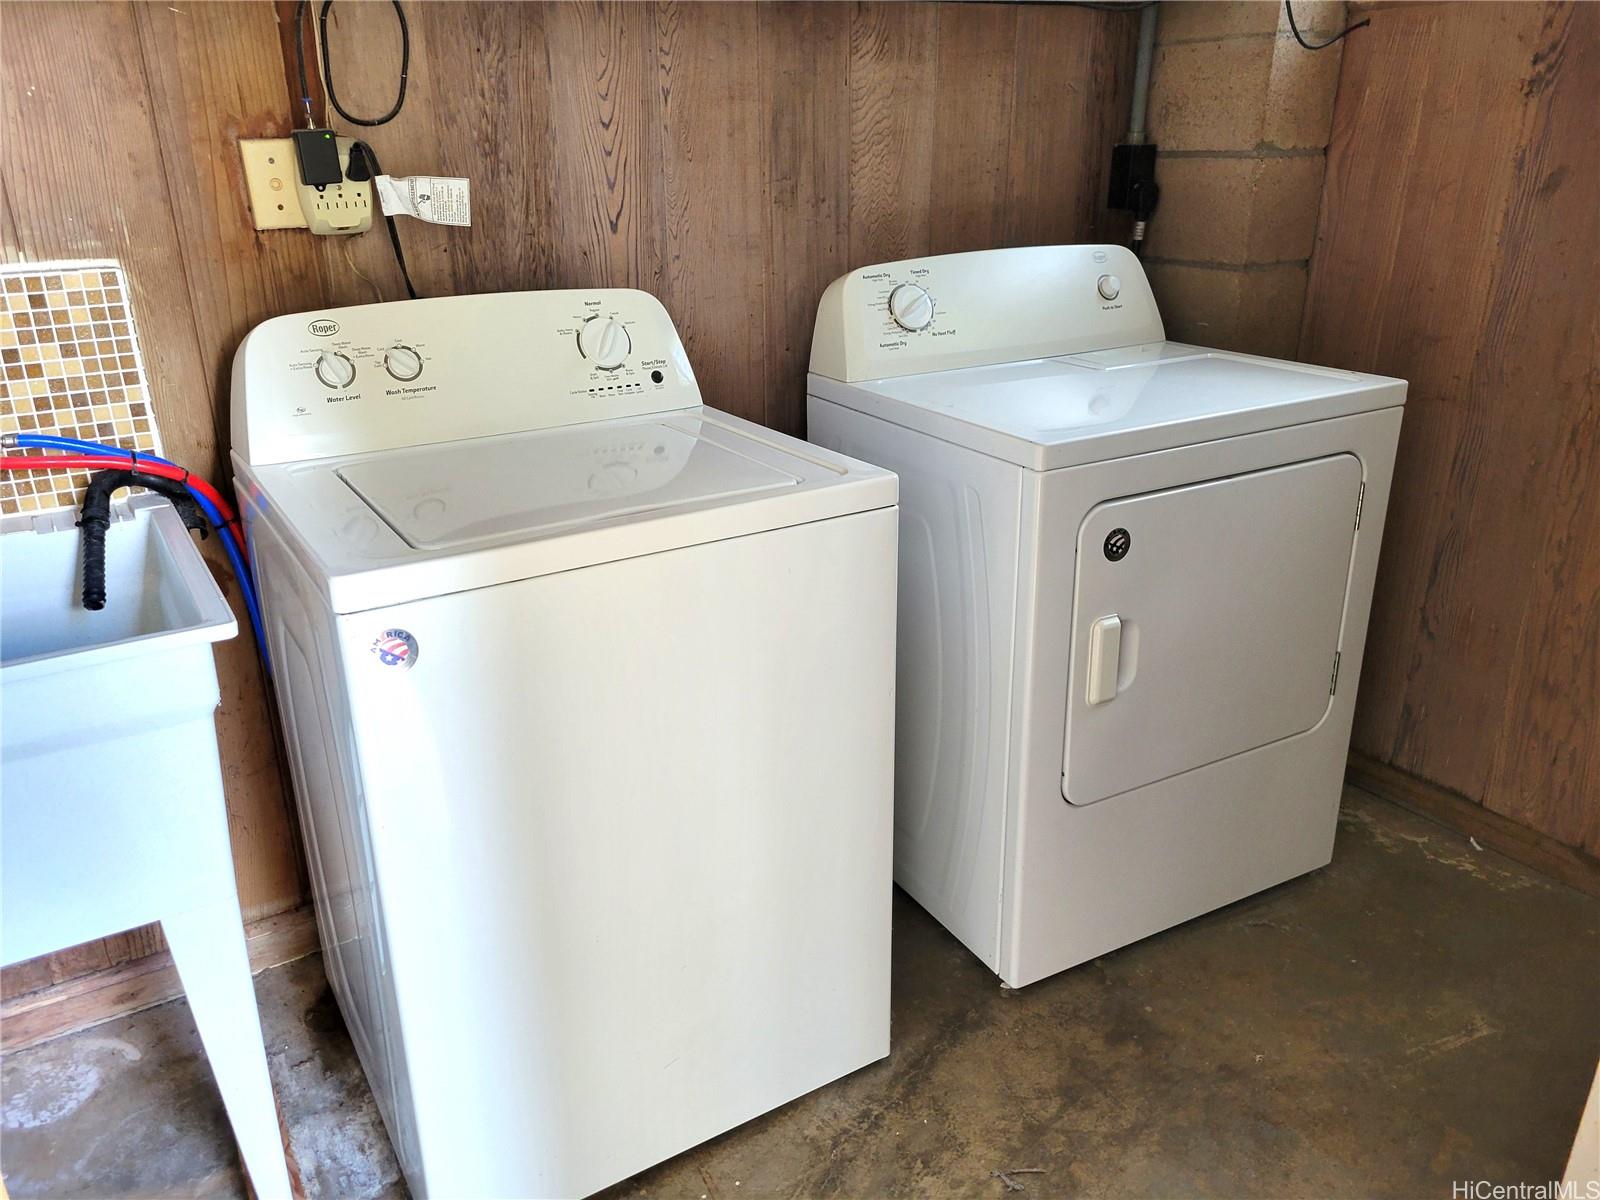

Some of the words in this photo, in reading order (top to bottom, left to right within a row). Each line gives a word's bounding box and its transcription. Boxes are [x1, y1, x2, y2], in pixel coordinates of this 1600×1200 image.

[311, 324, 337, 334] Roper
[402, 386, 437, 394] Temperature
[345, 393, 361, 401] Level
